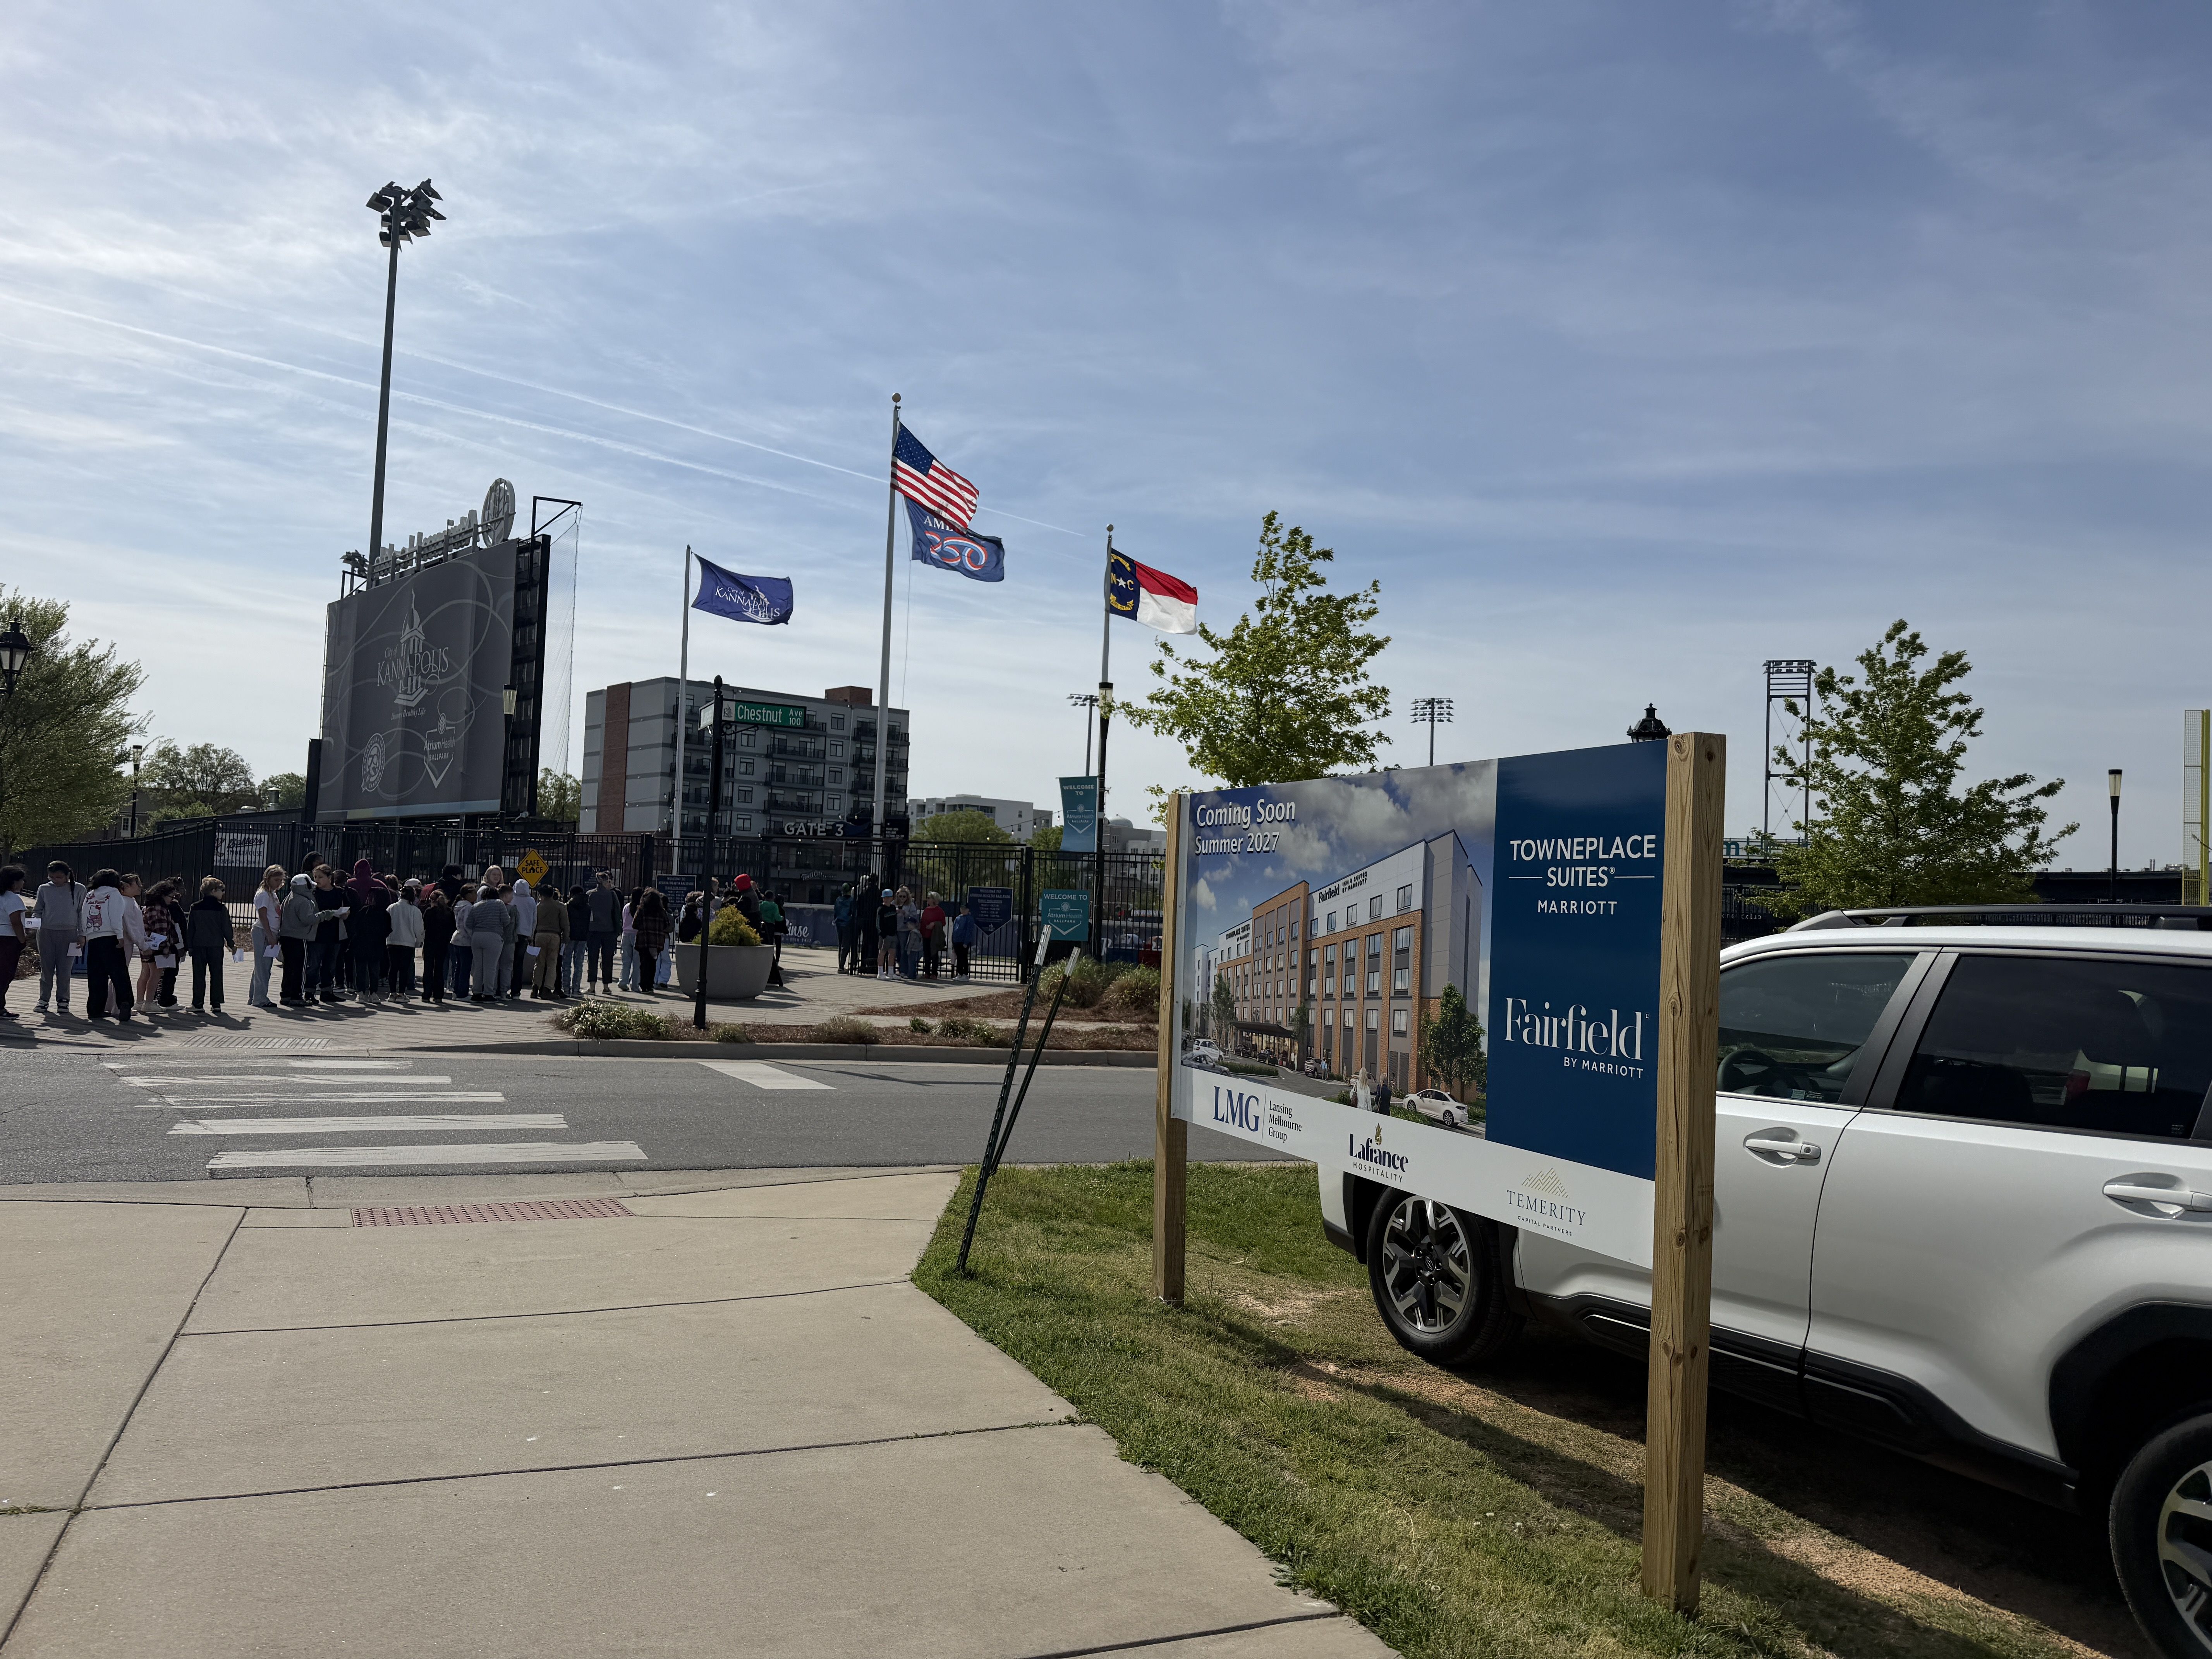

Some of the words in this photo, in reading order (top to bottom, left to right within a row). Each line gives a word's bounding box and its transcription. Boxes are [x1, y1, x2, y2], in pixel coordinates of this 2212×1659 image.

[924, 531, 988, 571] 250
[1127, 580, 1134, 591] C
[715, 586, 780, 617] KANNAPOIS
[377, 647, 448, 687] KANNAPOLIS
[737, 704, 782, 723] Chestnut
[789, 709, 803, 717] Ave
[790, 718, 801, 726] 100
[1197, 802, 1251, 829] Coming
[1256, 799, 1295, 823] Soon
[784, 822, 826, 836] GATE
[835, 824, 844, 836] 3
[1195, 836, 1243, 854] Summer
[1247, 831, 1279, 852] 2027
[1510, 835, 1656, 861] TOWNEPLACE
[1353, 871, 1367, 882] SUITES
[1318, 883, 1340, 903] Fairfield
[1347, 878, 1367, 891] MARRIOTT
[1537, 900, 1617, 915] MARRIOTT
[1504, 997, 1644, 1060] Fairfield
[1564, 1057, 1577, 1068] BY
[1582, 1060, 1644, 1079] MARRIOTT
[1213, 1085, 1259, 1132] LMG
[1269, 1100, 1292, 1118] Lansing
[1269, 1113, 1302, 1132] Melbourne
[1268, 1127, 1287, 1143] Group
[1349, 1133, 1409, 1173] Lafrance
[1353, 1161, 1403, 1183] HOSPITALITY
[1506, 1190, 1586, 1226] TEMERITY
[1517, 1216, 1540, 1226] CAPITAL
[1543, 1223, 1572, 1236] PARTNERS
